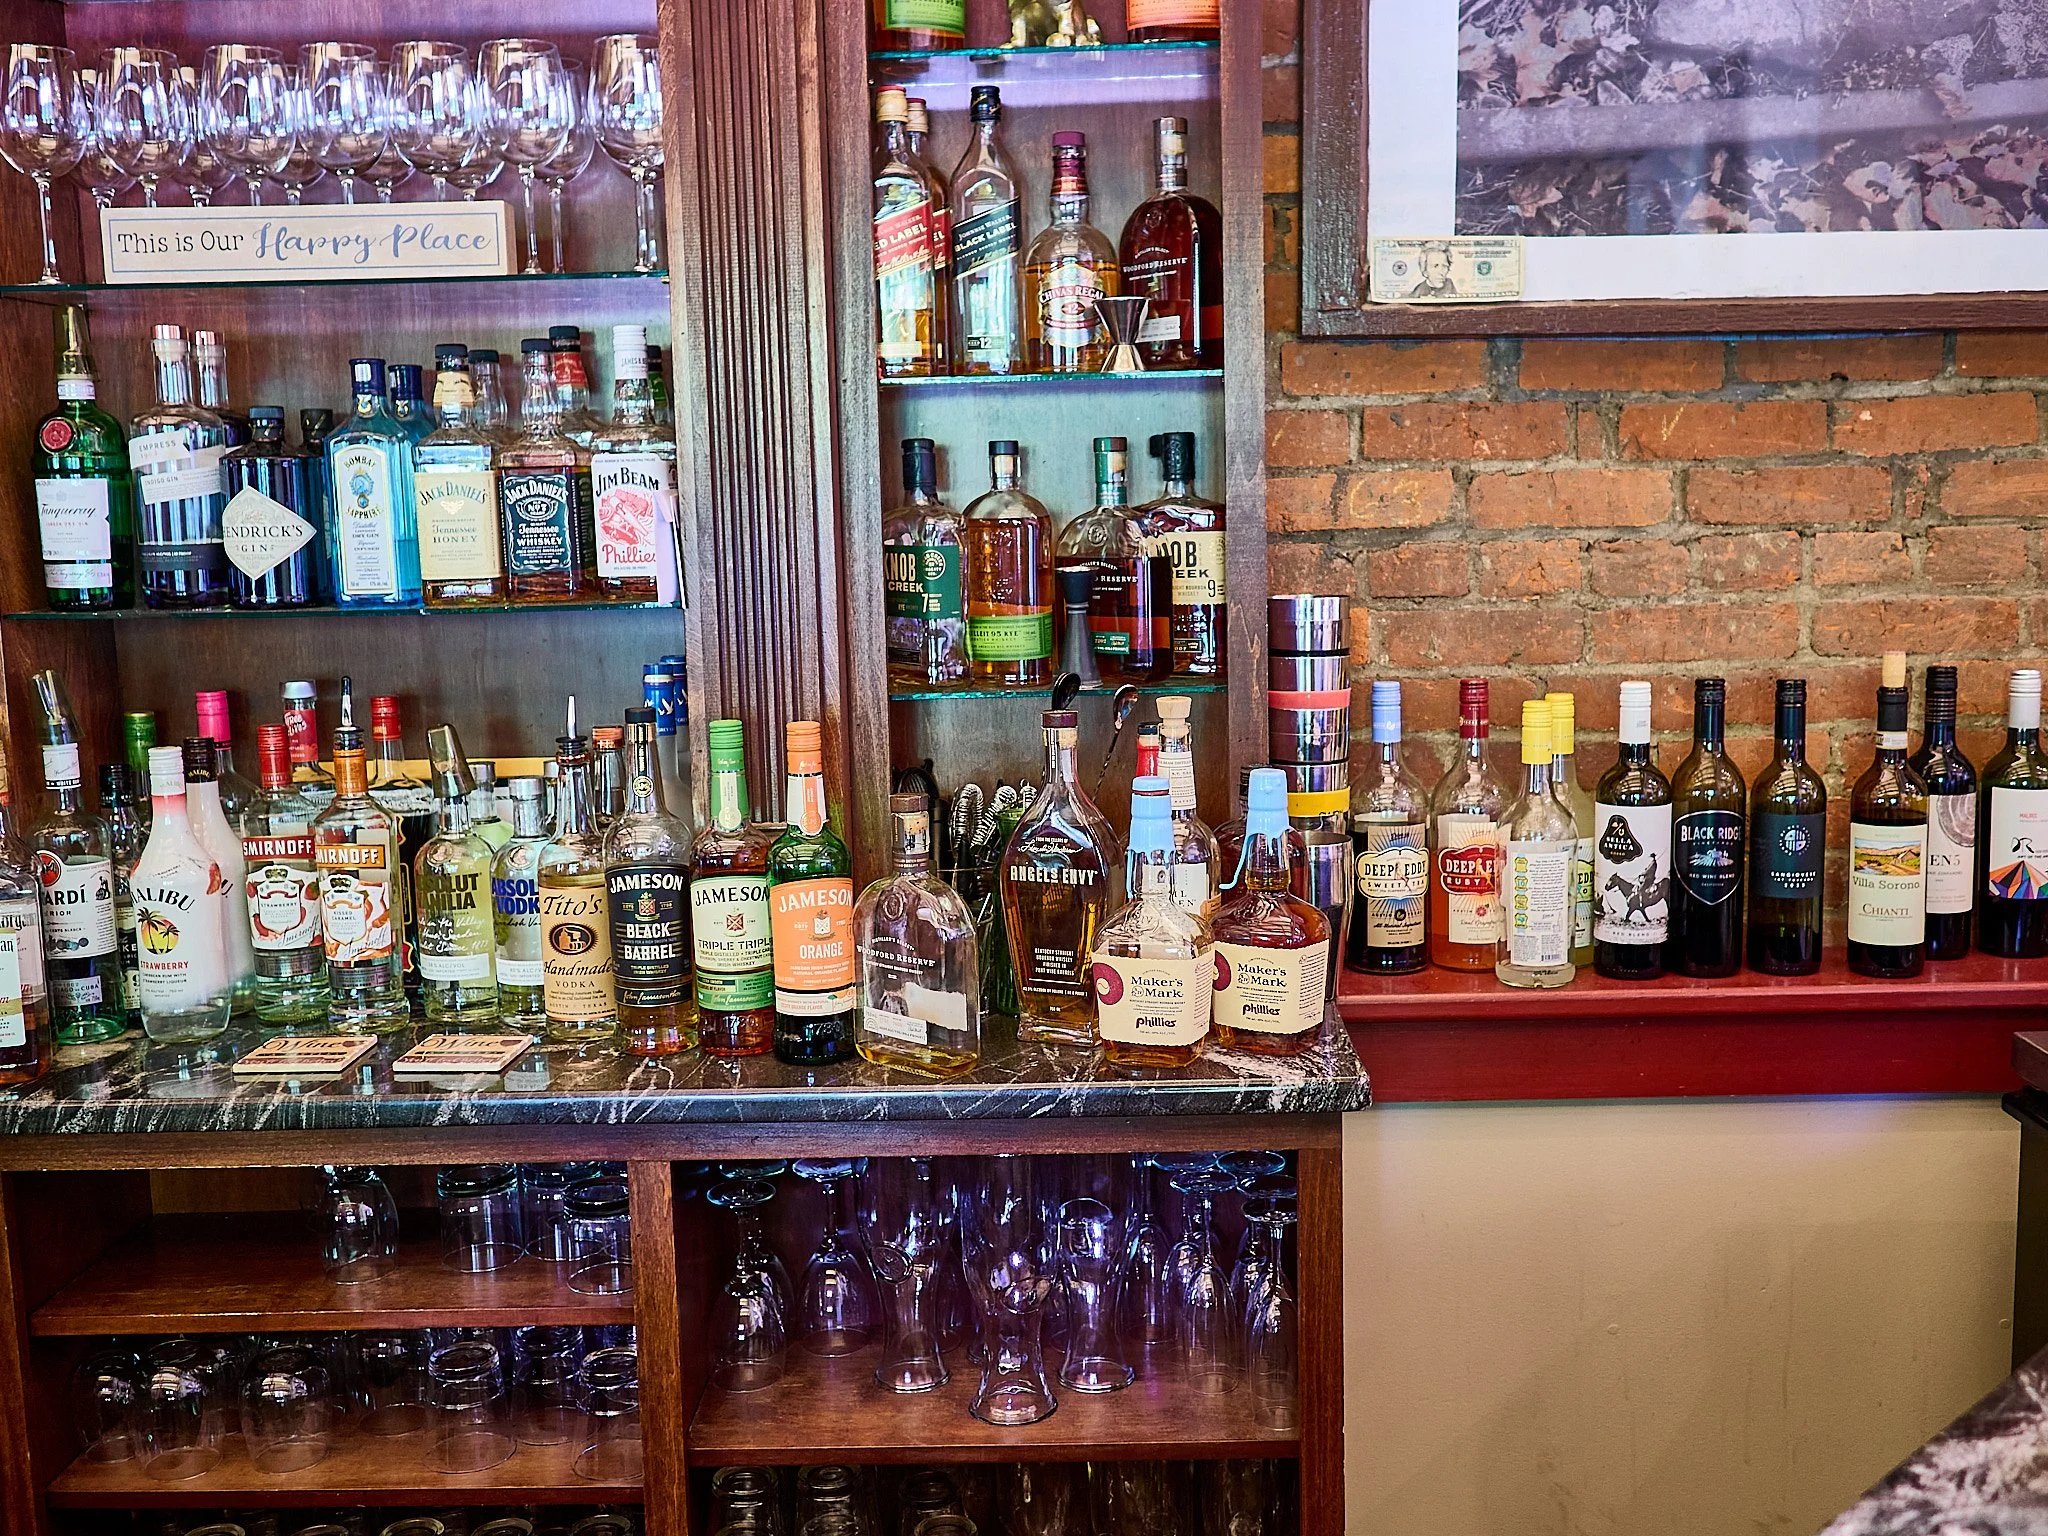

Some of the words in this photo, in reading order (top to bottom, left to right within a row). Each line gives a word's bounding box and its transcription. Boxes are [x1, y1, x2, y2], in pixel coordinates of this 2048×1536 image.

[889, 222, 928, 244] LABEL
[954, 233, 986, 253] BLACK
[985, 222, 1017, 239] LABEL
[117, 232, 168, 254] This
[175, 231, 194, 253] is
[200, 230, 244, 252] Our
[252, 222, 377, 264] Happy
[380, 223, 492, 259] Place
[1155, 257, 1188, 269] RESERVE
[1039, 286, 1074, 304] CHIVAS
[1067, 303, 1080, 314] 12
[979, 337, 992, 349] 12
[138, 440, 177, 452] EMPRESS
[344, 455, 376, 470] BOMBAY
[595, 472, 618, 498] JIM
[620, 466, 659, 491] BEAM
[419, 483, 445, 506] JACK
[445, 480, 488, 504] DANIEL'S
[504, 484, 530, 505] JACK
[528, 479, 569, 504] DANIEL'S
[41, 503, 96, 518] Tanqueray
[346, 505, 383, 520] SAPPHIRE
[223, 524, 303, 538] ENDRICK'S
[432, 524, 477, 535] Tennessee
[518, 523, 560, 535] Tennessee
[433, 535, 478, 544] HONEY
[516, 537, 563, 547] WHISKEY
[241, 544, 267, 552] GIN
[884, 552, 916, 582] KNOB
[1171, 568, 1210, 579] EEK
[1100, 575, 1138, 583] RESERVE
[888, 581, 924, 593] CREEK
[1207, 579, 1216, 598] 9
[921, 592, 929, 613] 7
[187, 768, 212, 779] MALIBU
[1606, 836, 1632, 845] SELLA
[1681, 824, 1714, 842] BLACK
[242, 839, 313, 857] SMIRNOFF
[1603, 842, 1634, 851] ANTICA
[316, 848, 379, 864] MIRNOFF
[1927, 854, 1961, 867] EN5
[1364, 863, 1395, 876] DEEP
[1404, 860, 1426, 876] EDDY
[1445, 858, 1476, 875] DEEP
[1770, 870, 1816, 878] SANGIOVESE
[425, 873, 479, 892] SOLUT
[610, 873, 684, 894] JAMESON
[1062, 867, 1095, 886] ENVY
[1446, 877, 1481, 886] RUBY
[1852, 875, 1875, 889] Villa
[1878, 879, 1920, 890] Sorono
[44, 883, 86, 906] ARDÍ
[491, 878, 539, 897] ABSOL
[428, 891, 477, 911] NILIA
[695, 885, 770, 907] JAMESON
[778, 888, 853, 913] JAMESON
[494, 896, 540, 915] VODK
[543, 894, 603, 916] Tito's
[1862, 903, 1909, 916] CHIANTI
[0, 912, 36, 932] organ
[626, 921, 671, 939] BLACK
[624, 943, 676, 961] BARREL
[697, 939, 734, 951] TRIPLE
[799, 941, 843, 960] ORANGE
[856, 944, 895, 961] WOODFORD
[896, 951, 936, 968] RESERVE
[140, 960, 189, 970] STRAWBERRY
[543, 956, 613, 976] Handmade
[1237, 962, 1287, 977] Maker's
[555, 980, 596, 989] VODKA
[1130, 976, 1184, 987] Maker's
[1250, 975, 1287, 988] Mark
[1145, 988, 1184, 998] Mark
[1242, 1003, 1281, 1016] phillies
[1135, 1016, 1177, 1029] phillies
[263, 1039, 342, 1051] Wine
[420, 1037, 500, 1050] Wine
